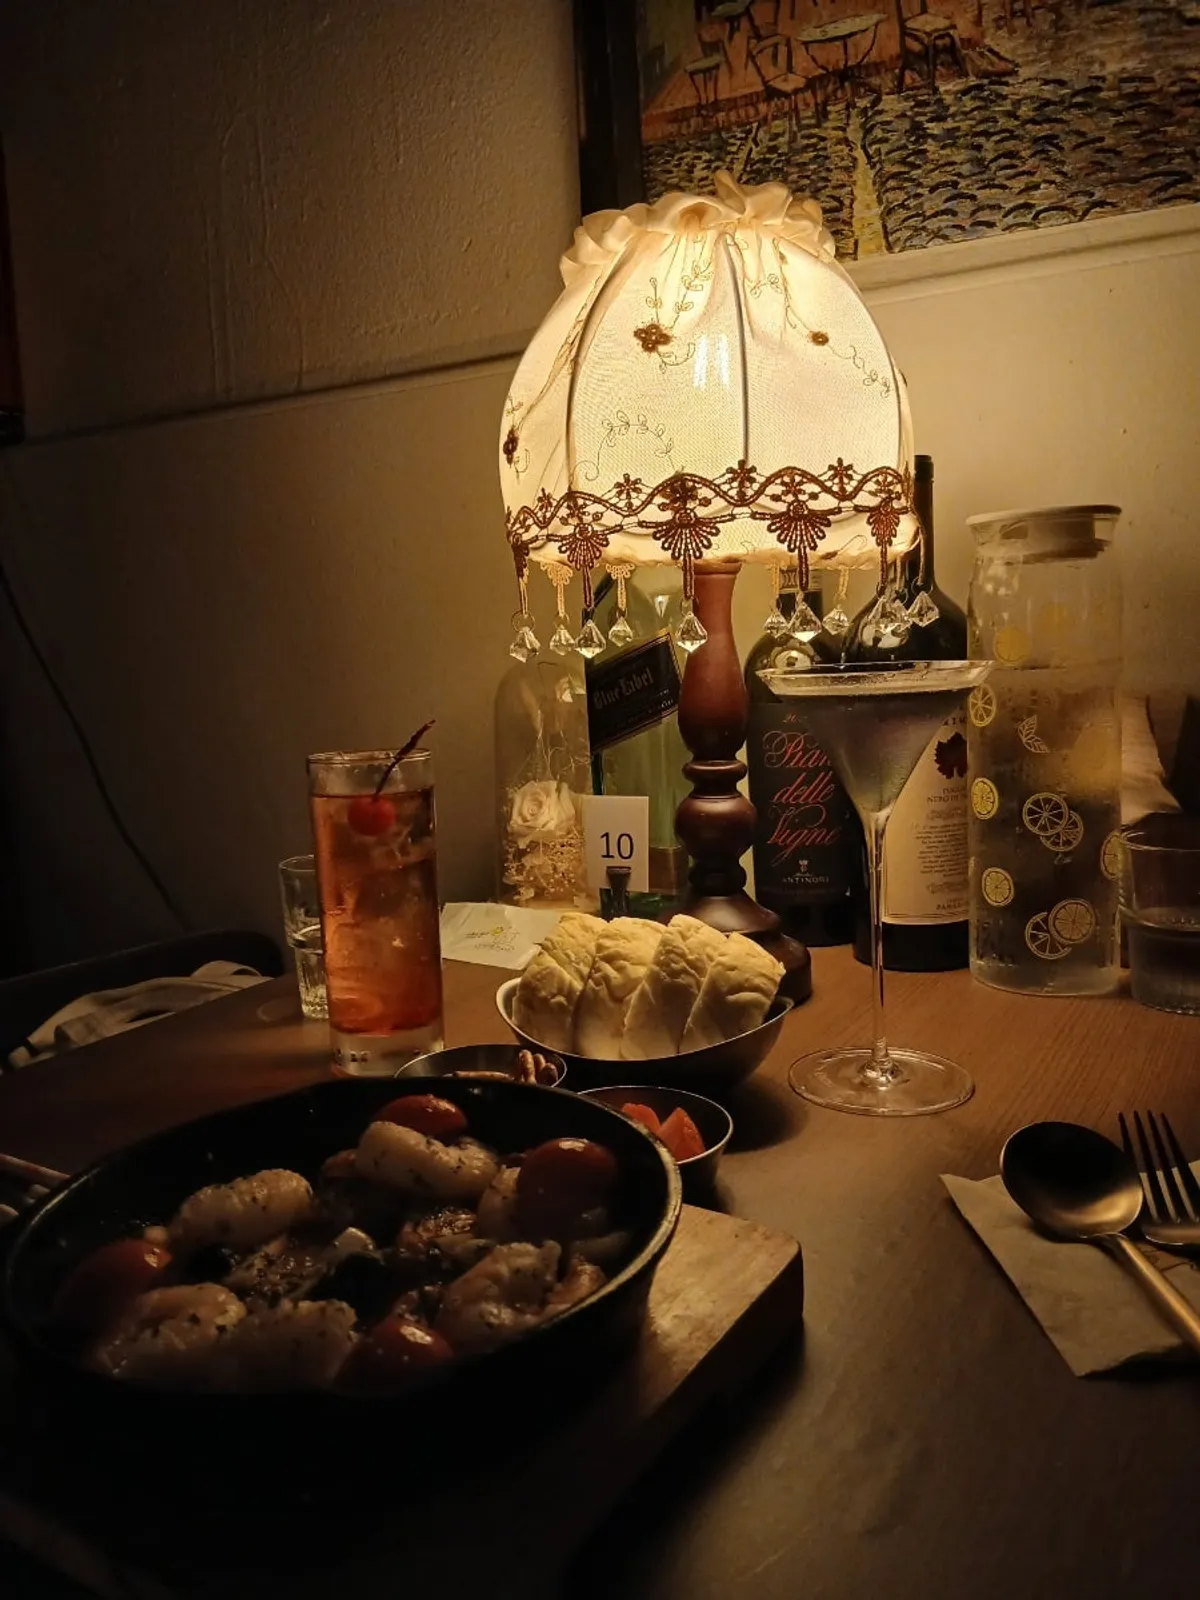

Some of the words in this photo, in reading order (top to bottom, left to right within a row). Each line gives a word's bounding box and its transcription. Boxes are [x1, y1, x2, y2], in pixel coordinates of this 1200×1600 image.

[619, 666, 655, 696] Label
[770, 770, 836, 804] delle
[600, 831, 634, 860] 10
[766, 804, 842, 867] Vigne
